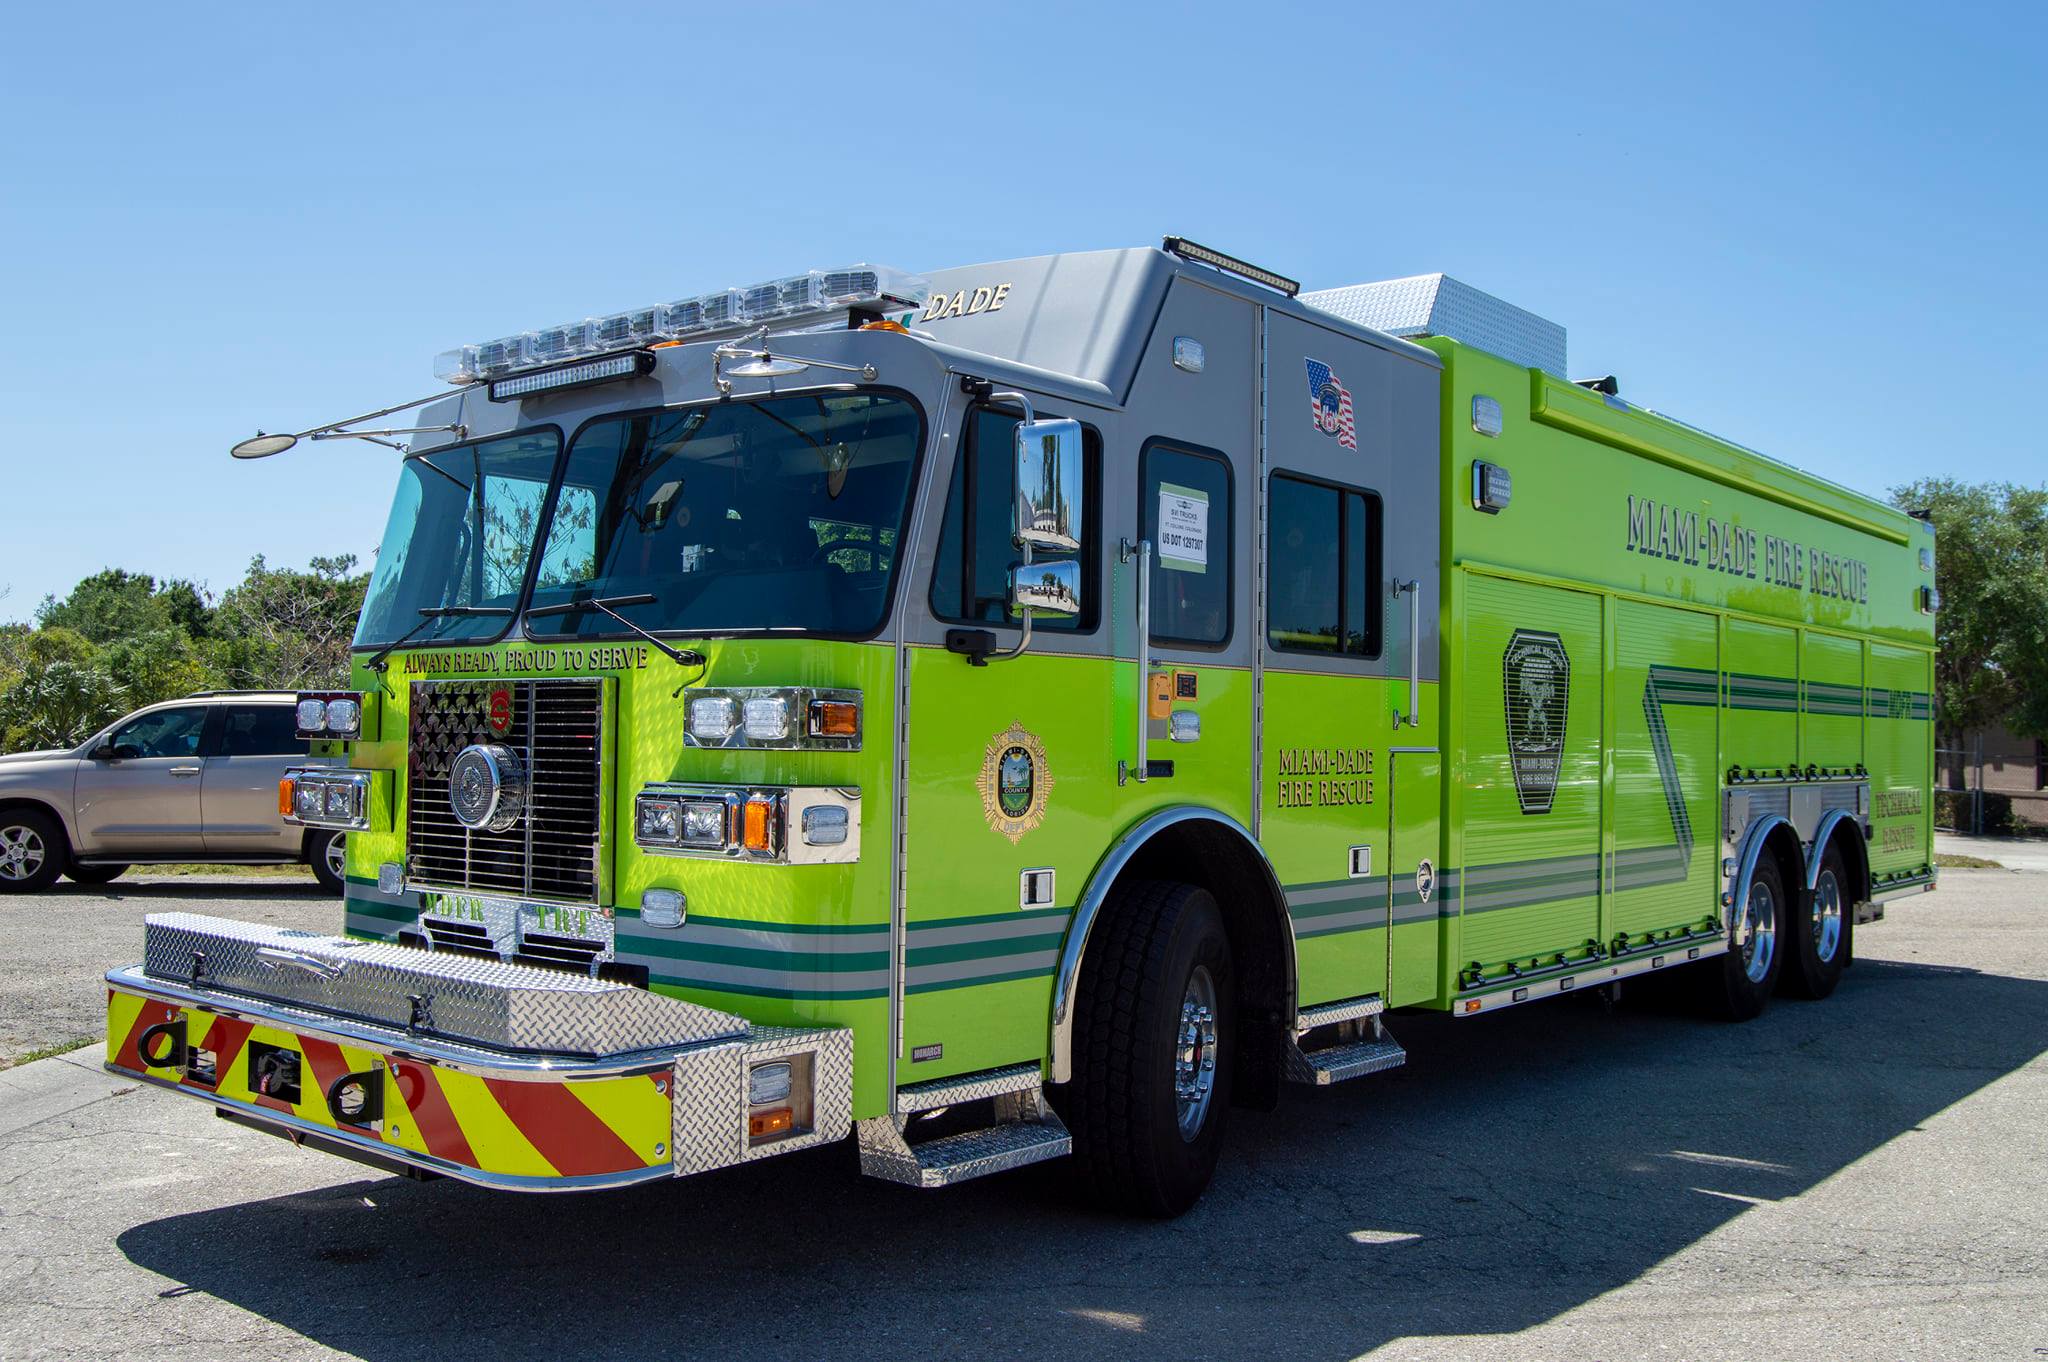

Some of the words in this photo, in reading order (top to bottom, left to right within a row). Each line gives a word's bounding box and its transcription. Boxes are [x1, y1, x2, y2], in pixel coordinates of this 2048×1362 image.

[921, 282, 1012, 323] DADE
[1162, 532, 1170, 545] US
[1170, 533, 1182, 547] DOT
[1627, 495, 1757, 579] MIAMI-DADE
[1765, 535, 1802, 590] FIRE
[1809, 548, 1868, 605] RESCUE
[404, 653, 451, 673] ALWAYS
[454, 651, 500, 675] READY,
[505, 650, 557, 671] PROUD
[562, 649, 584, 670] TO
[589, 646, 648, 670] SERVE
[1279, 749, 1373, 775] MIAMI-DADE
[1278, 781, 1312, 808] FIRE
[1319, 780, 1373, 806] RESCUE
[425, 892, 484, 922] MDFR
[536, 905, 592, 935] TRT
